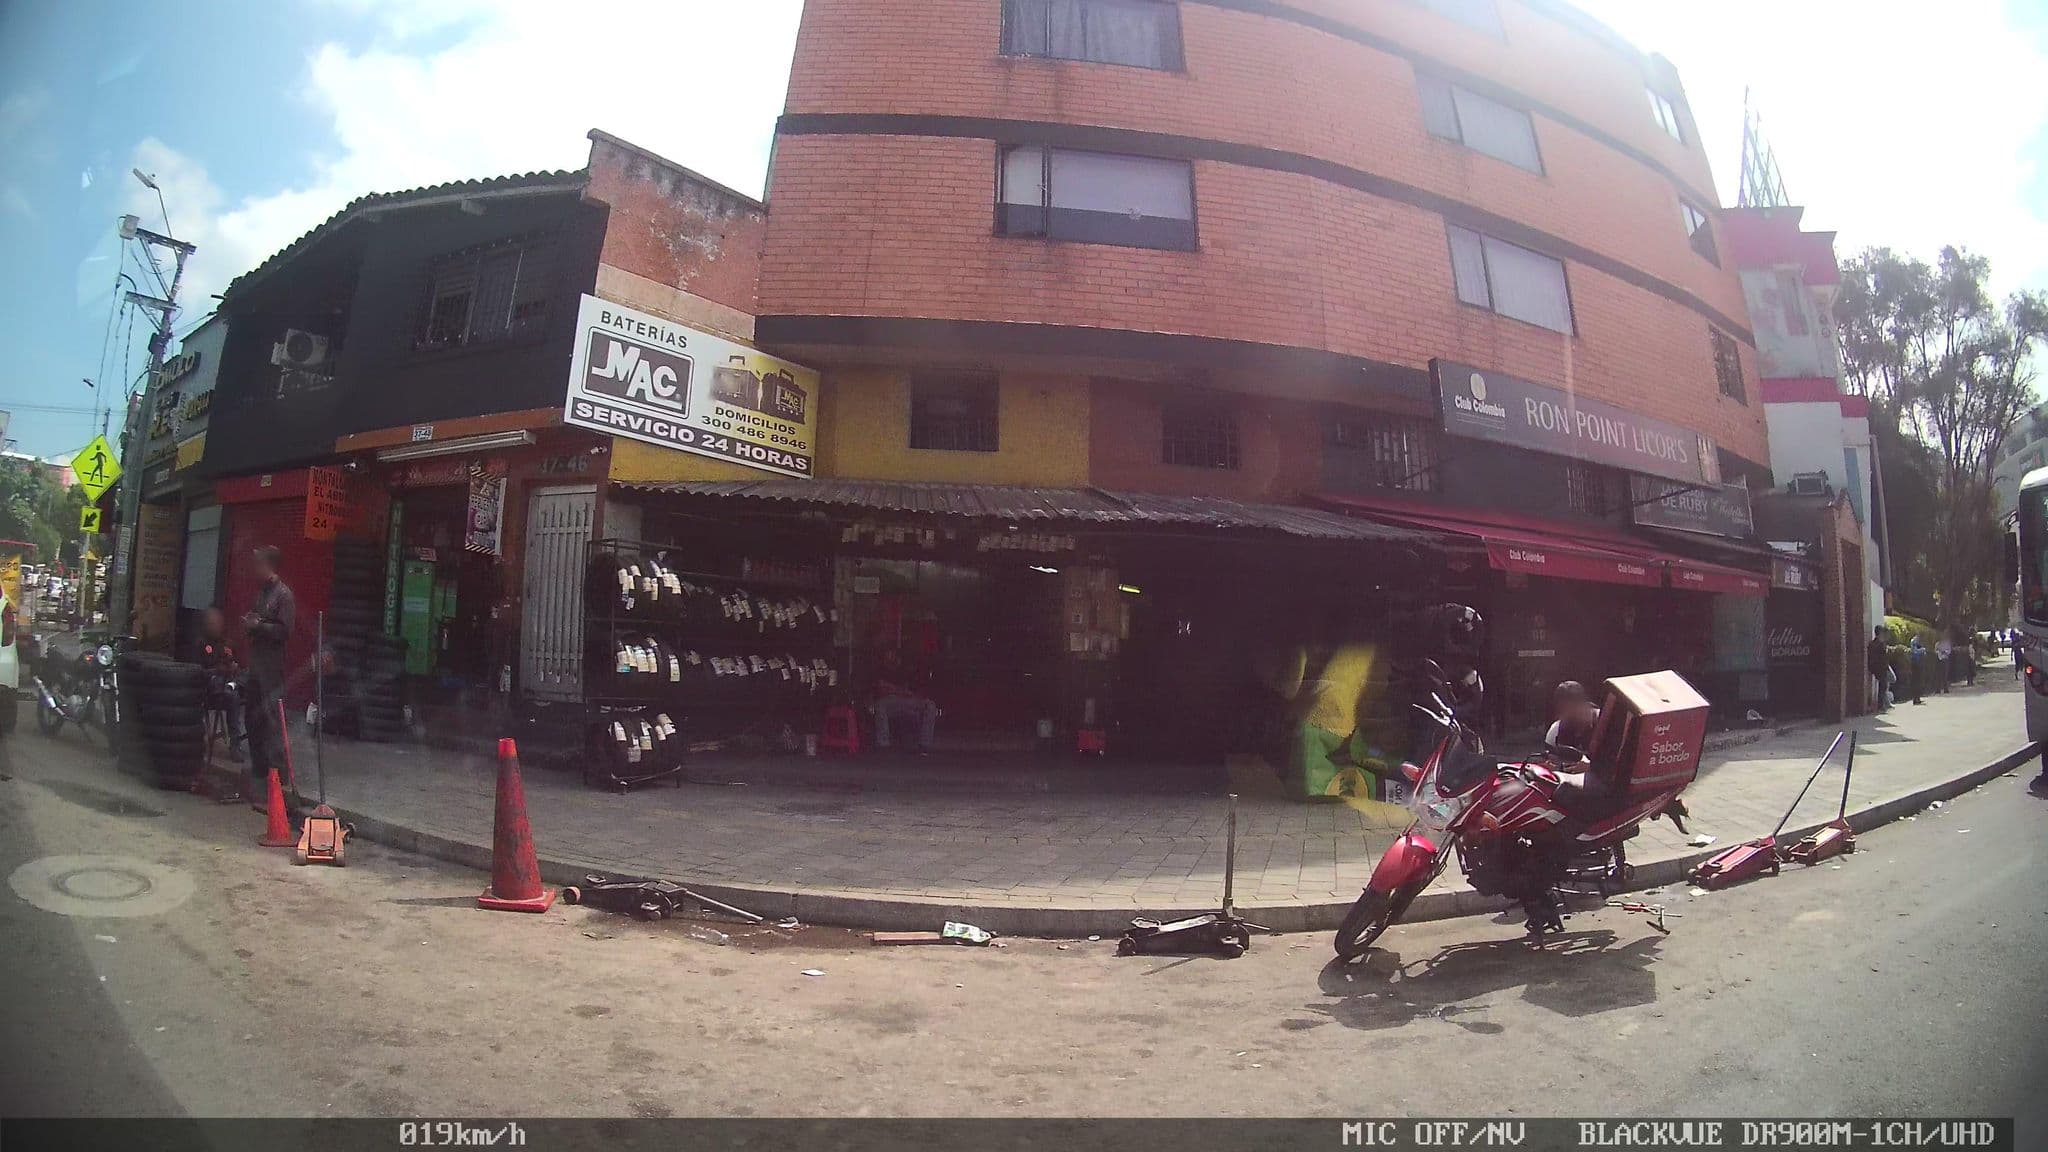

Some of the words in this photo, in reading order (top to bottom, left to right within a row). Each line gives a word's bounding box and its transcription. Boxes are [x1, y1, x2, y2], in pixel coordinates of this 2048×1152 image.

[601, 310, 688, 348] BATERÍAS
[592, 340, 680, 402] MAC
[715, 406, 796, 435] DOMICILIOS
[1455, 394, 1472, 411] Club
[1473, 398, 1506, 418] Colombia
[575, 402, 694, 443] SERVICIO
[701, 434, 728, 451] 24
[736, 443, 808, 471] HORAS
[702, 415, 731, 431] 300
[737, 425, 766, 440] 486
[771, 434, 807, 451] 8946
[1525, 398, 1570, 435] RON
[1576, 410, 1627, 448] POINT
[1679, 497, 1708, 513] RUBY
[1649, 757, 1656, 765] a
[1658, 751, 1690, 764] bordo
[1651, 741, 1684, 754] Sabor
